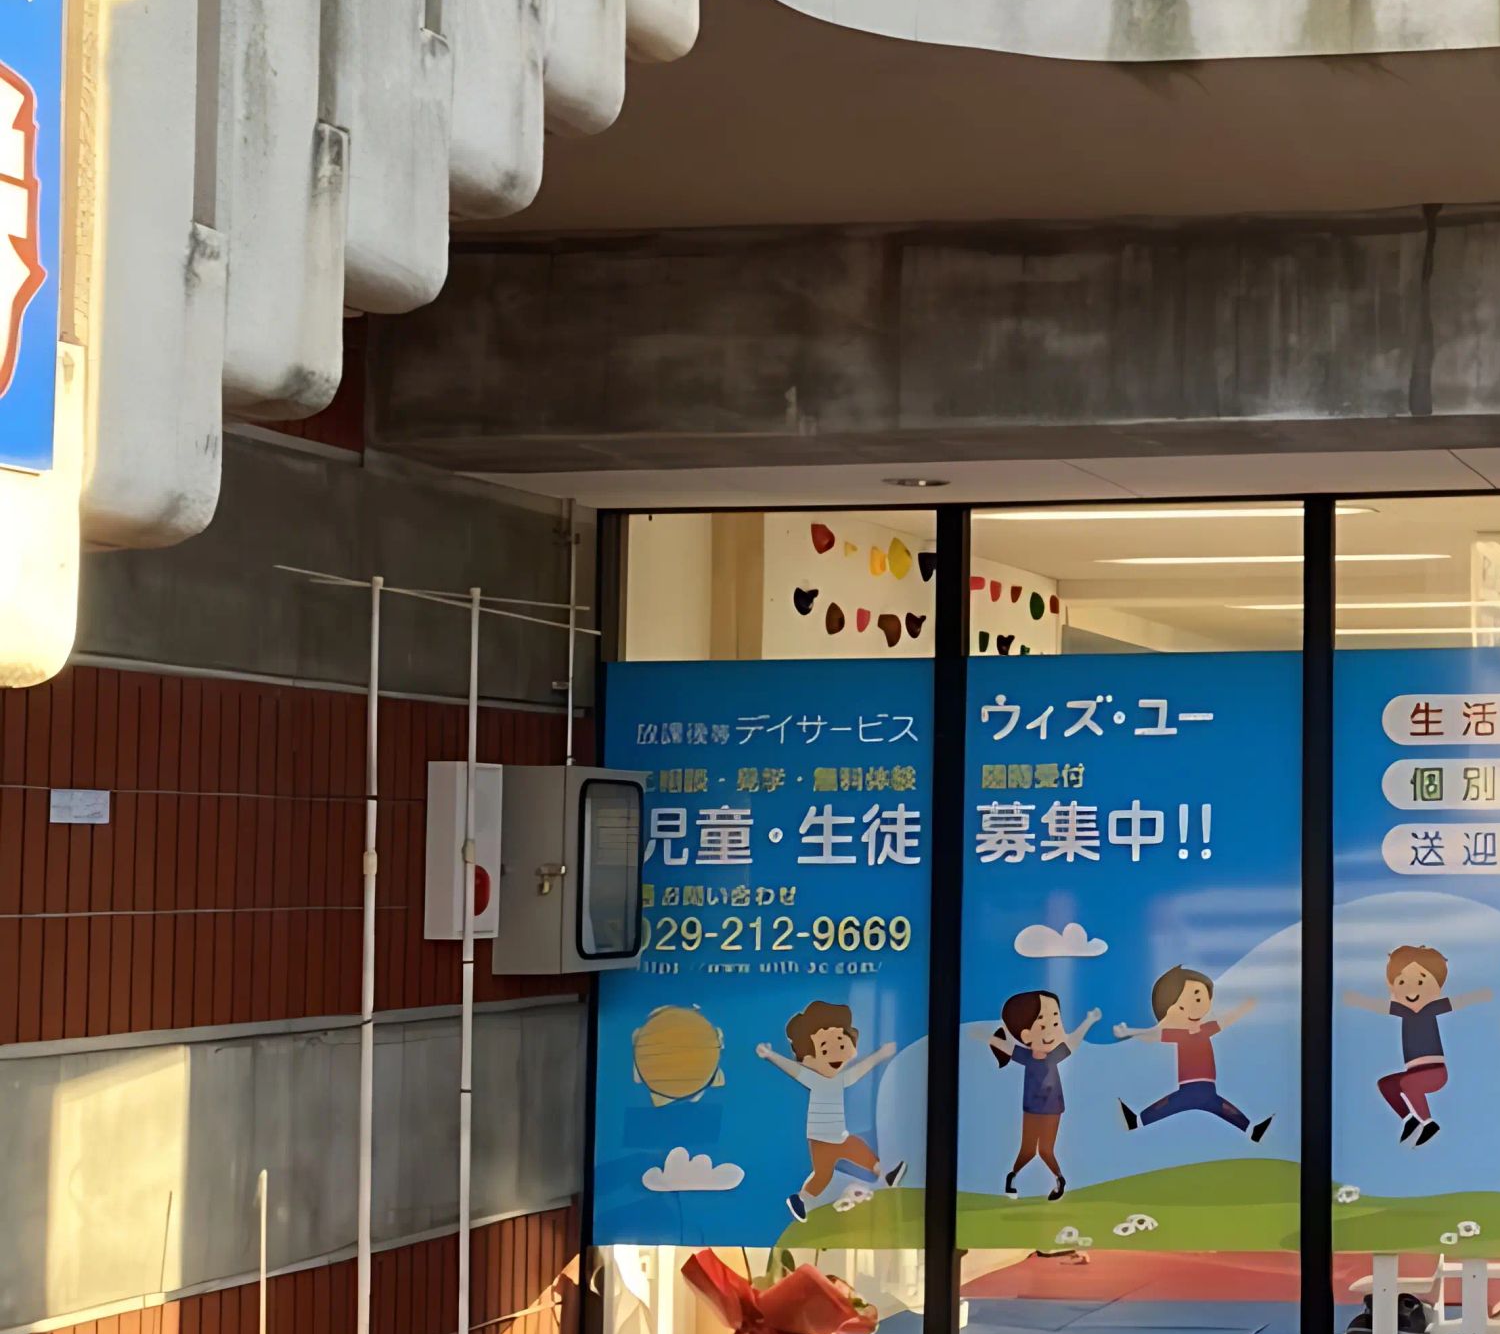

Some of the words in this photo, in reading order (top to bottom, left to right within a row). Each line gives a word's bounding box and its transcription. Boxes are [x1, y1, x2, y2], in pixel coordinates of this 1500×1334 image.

[980, 694, 1214, 740] ウィズ・ユー
[643, 803, 921, 866] 児童・生徒
